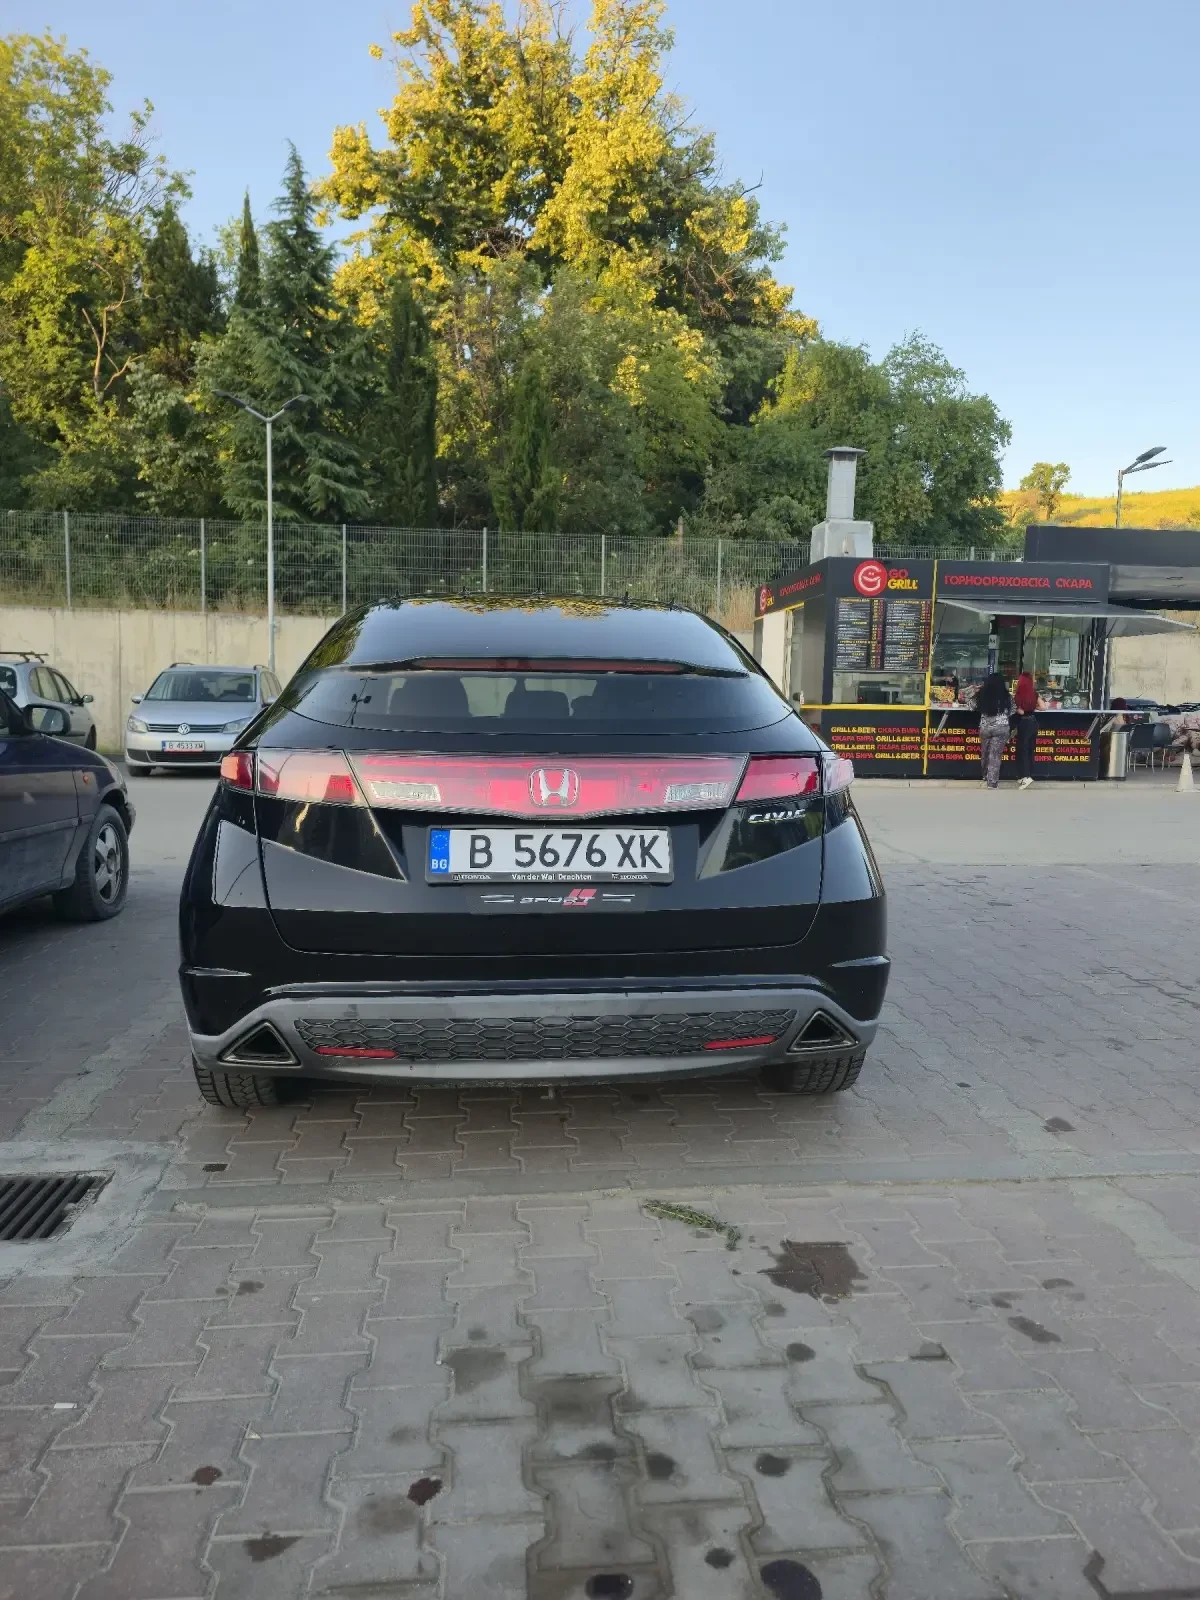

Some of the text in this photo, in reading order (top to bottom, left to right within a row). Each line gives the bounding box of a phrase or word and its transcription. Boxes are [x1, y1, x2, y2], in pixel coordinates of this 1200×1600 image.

[888, 568, 909, 579] GO
[887, 578, 918, 590] GRILL
[944, 575, 1093, 589] ГОРНООРЯХОВСКА СКАРА
[469, 833, 663, 869] B 5676 XK
[431, 858, 448, 870] BG
[519, 896, 596, 904] SPORT
